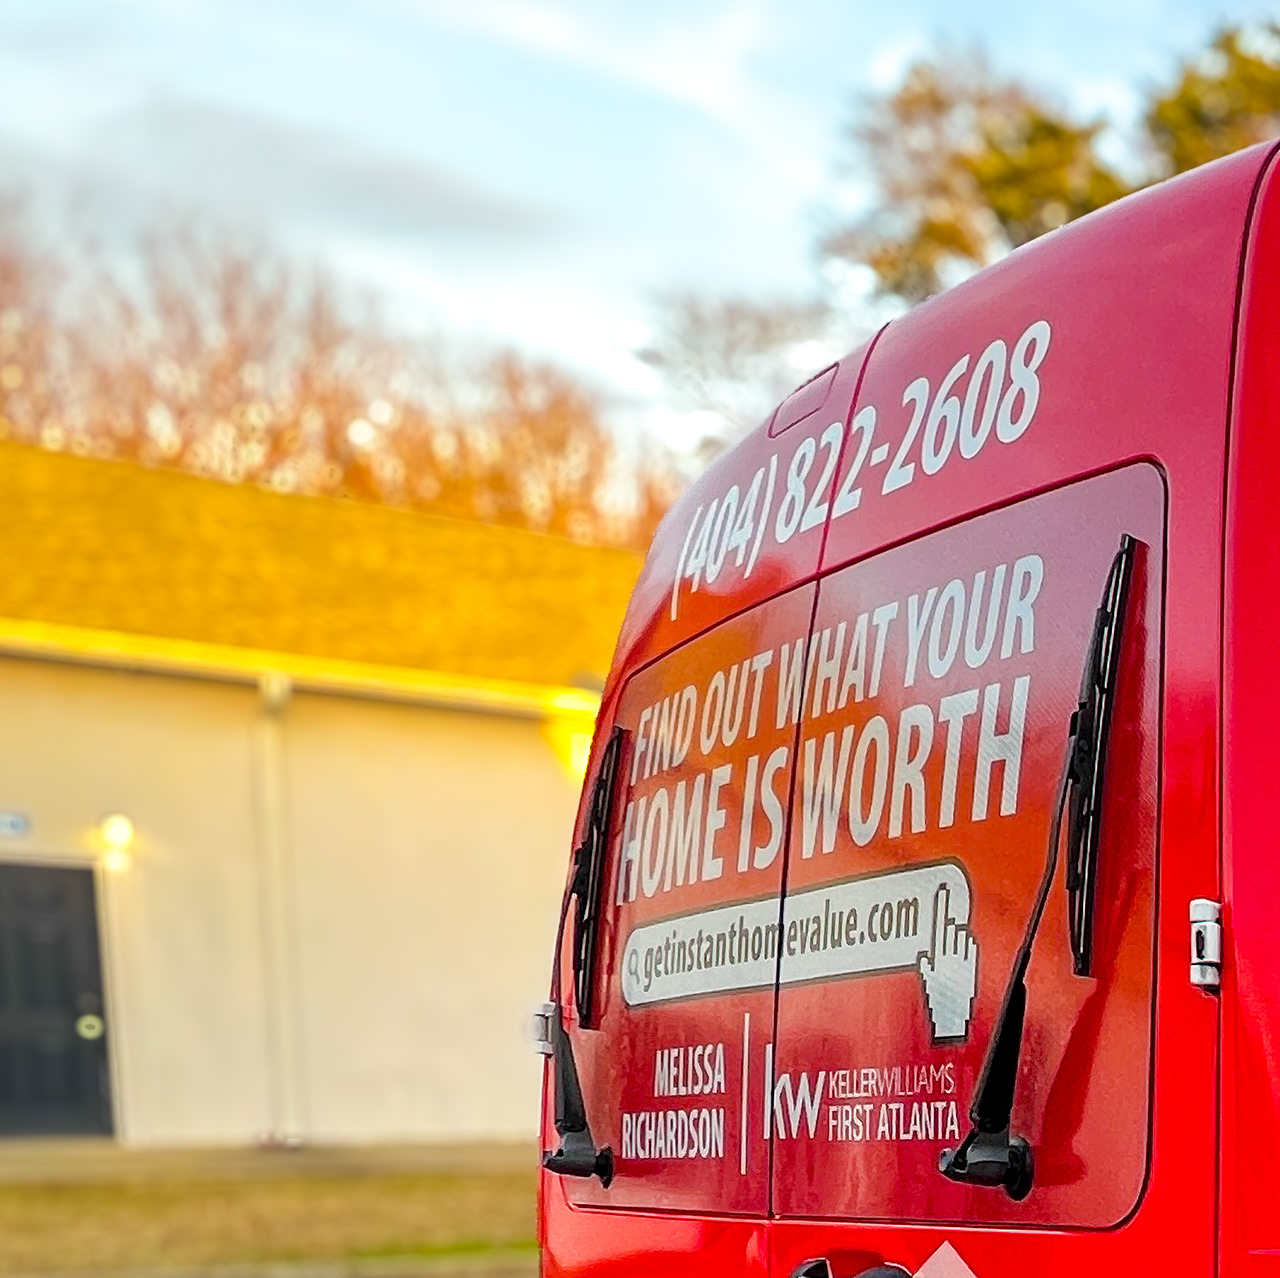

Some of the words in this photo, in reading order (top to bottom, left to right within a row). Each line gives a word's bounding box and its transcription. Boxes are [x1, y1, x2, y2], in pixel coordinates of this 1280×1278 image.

[670, 453, 776, 620] (404)
[775, 320, 1051, 544] 822-2608
[631, 684, 697, 786] FIND
[700, 650, 773, 755] OUT
[775, 601, 898, 729] WHAT
[903, 553, 1045, 688] YOUR
[616, 765, 731, 906] HOME
[736, 747, 788, 873] IS
[800, 675, 1032, 860] WORTH
[643, 893, 918, 991] getinstanthomevalue.com
[654, 1043, 725, 1097] MELISSA
[621, 1108, 725, 1160] RICHARDSON
[828, 1103, 873, 1141] FIRST
[876, 1101, 960, 1139] ATLANTA
